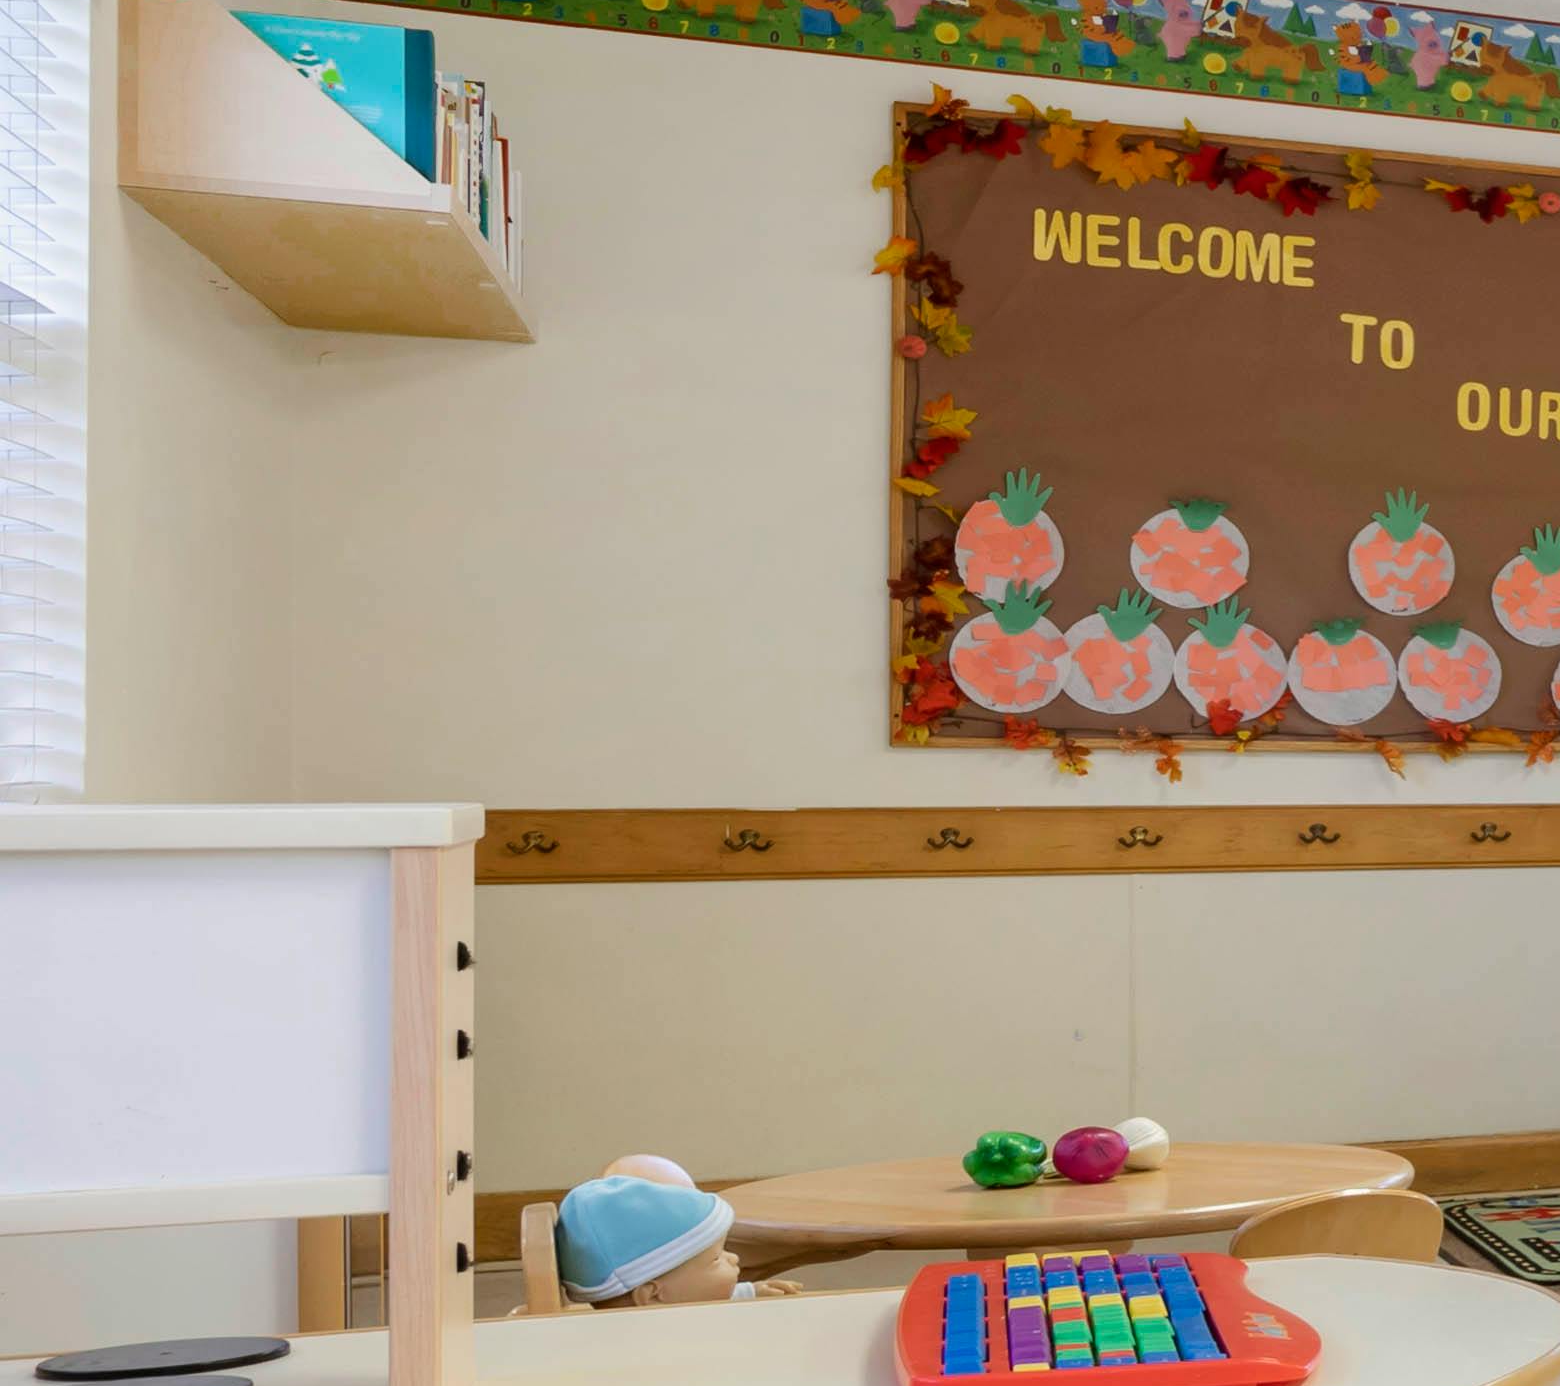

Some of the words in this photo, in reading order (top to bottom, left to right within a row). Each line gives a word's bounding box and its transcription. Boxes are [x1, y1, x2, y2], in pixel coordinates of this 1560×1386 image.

[523, 3, 532, 16] 2
[618, 14, 627, 26] 5
[680, 21, 688, 34] 7
[770, 31, 779, 43] 0
[798, 34, 804, 46] 1
[827, 38, 835, 50] 2
[913, 48, 921, 59] 5
[970, 54, 978, 65] 7
[1052, 63, 1061, 74] 0
[1079, 65, 1084, 76] 1
[1104, 69, 1112, 80] 2
[1184, 77, 1192, 88] 5
[1236, 83, 1244, 94] 7
[1311, 91, 1319, 102] 0
[1336, 93, 1340, 104] 1
[1360, 97, 1367, 107] 2
[1433, 105, 1440, 115] 5
[1481, 110, 1489, 120] 7
[1551, 118, 1558, 128] 0
[1033, 209, 1316, 289] WELCOME
[1340, 314, 1415, 370] TO
